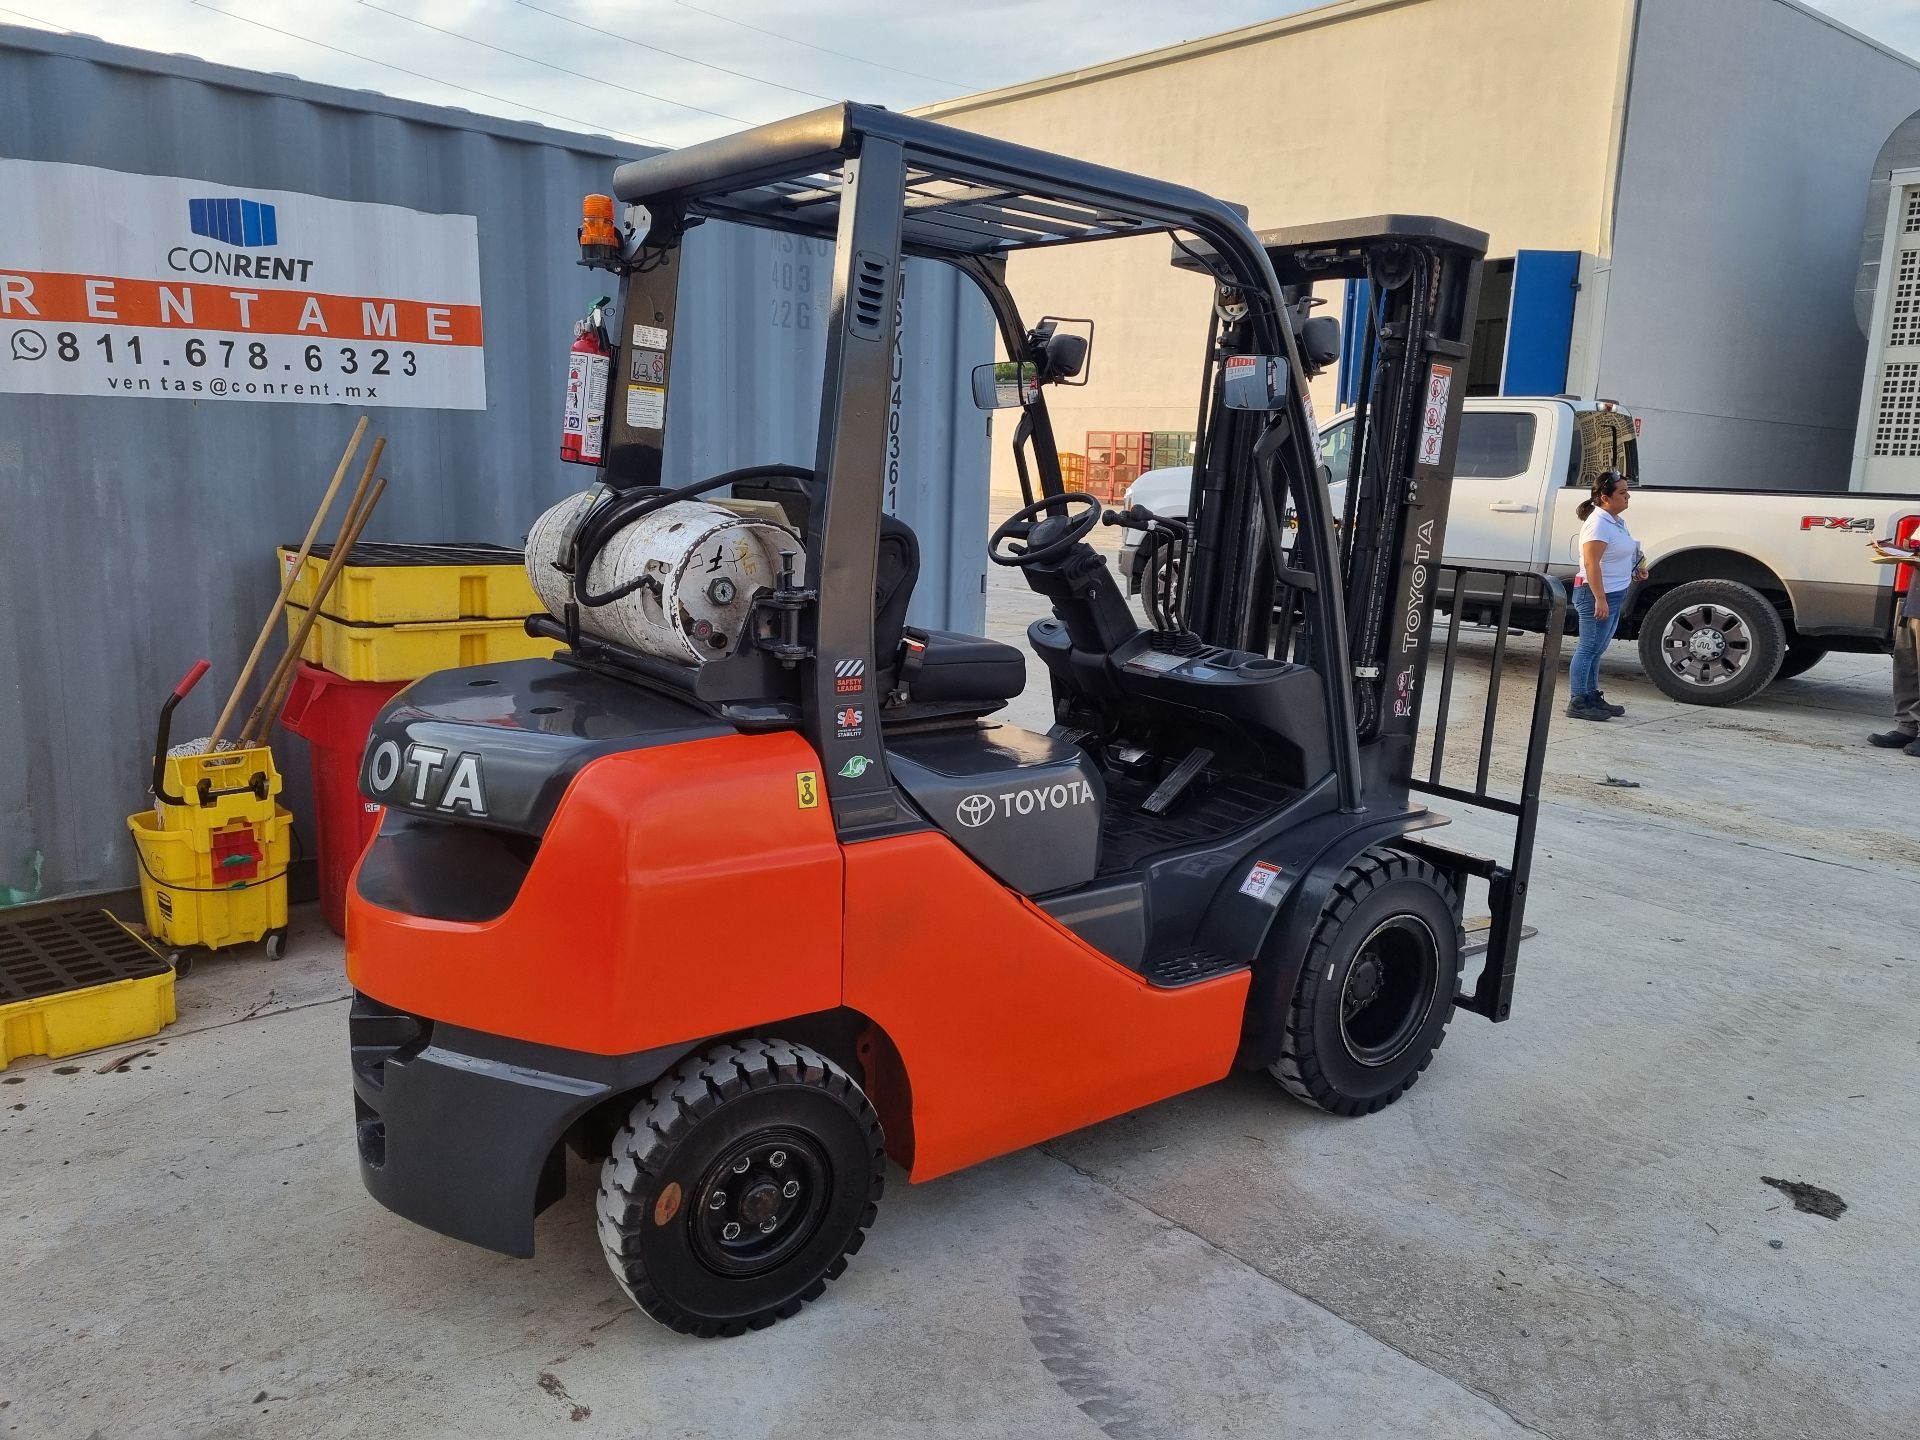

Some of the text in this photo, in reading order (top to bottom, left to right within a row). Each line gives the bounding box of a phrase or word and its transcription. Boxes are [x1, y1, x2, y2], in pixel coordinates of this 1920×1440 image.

[168, 246, 313, 282] CONRENT
[0, 274, 453, 341] RENTAME
[57, 331, 418, 376] 811.678.6323
[108, 376, 377, 398] ventas@conrent.mx
[1800, 516, 1875, 530] FX4
[1402, 519, 1434, 653] TOYOTA
[837, 678, 862, 686] SAFETY
[837, 684, 862, 692] LEADER
[837, 708, 863, 727] SAS
[370, 734, 487, 815] OTA
[1000, 780, 1095, 818] TOYOTA
